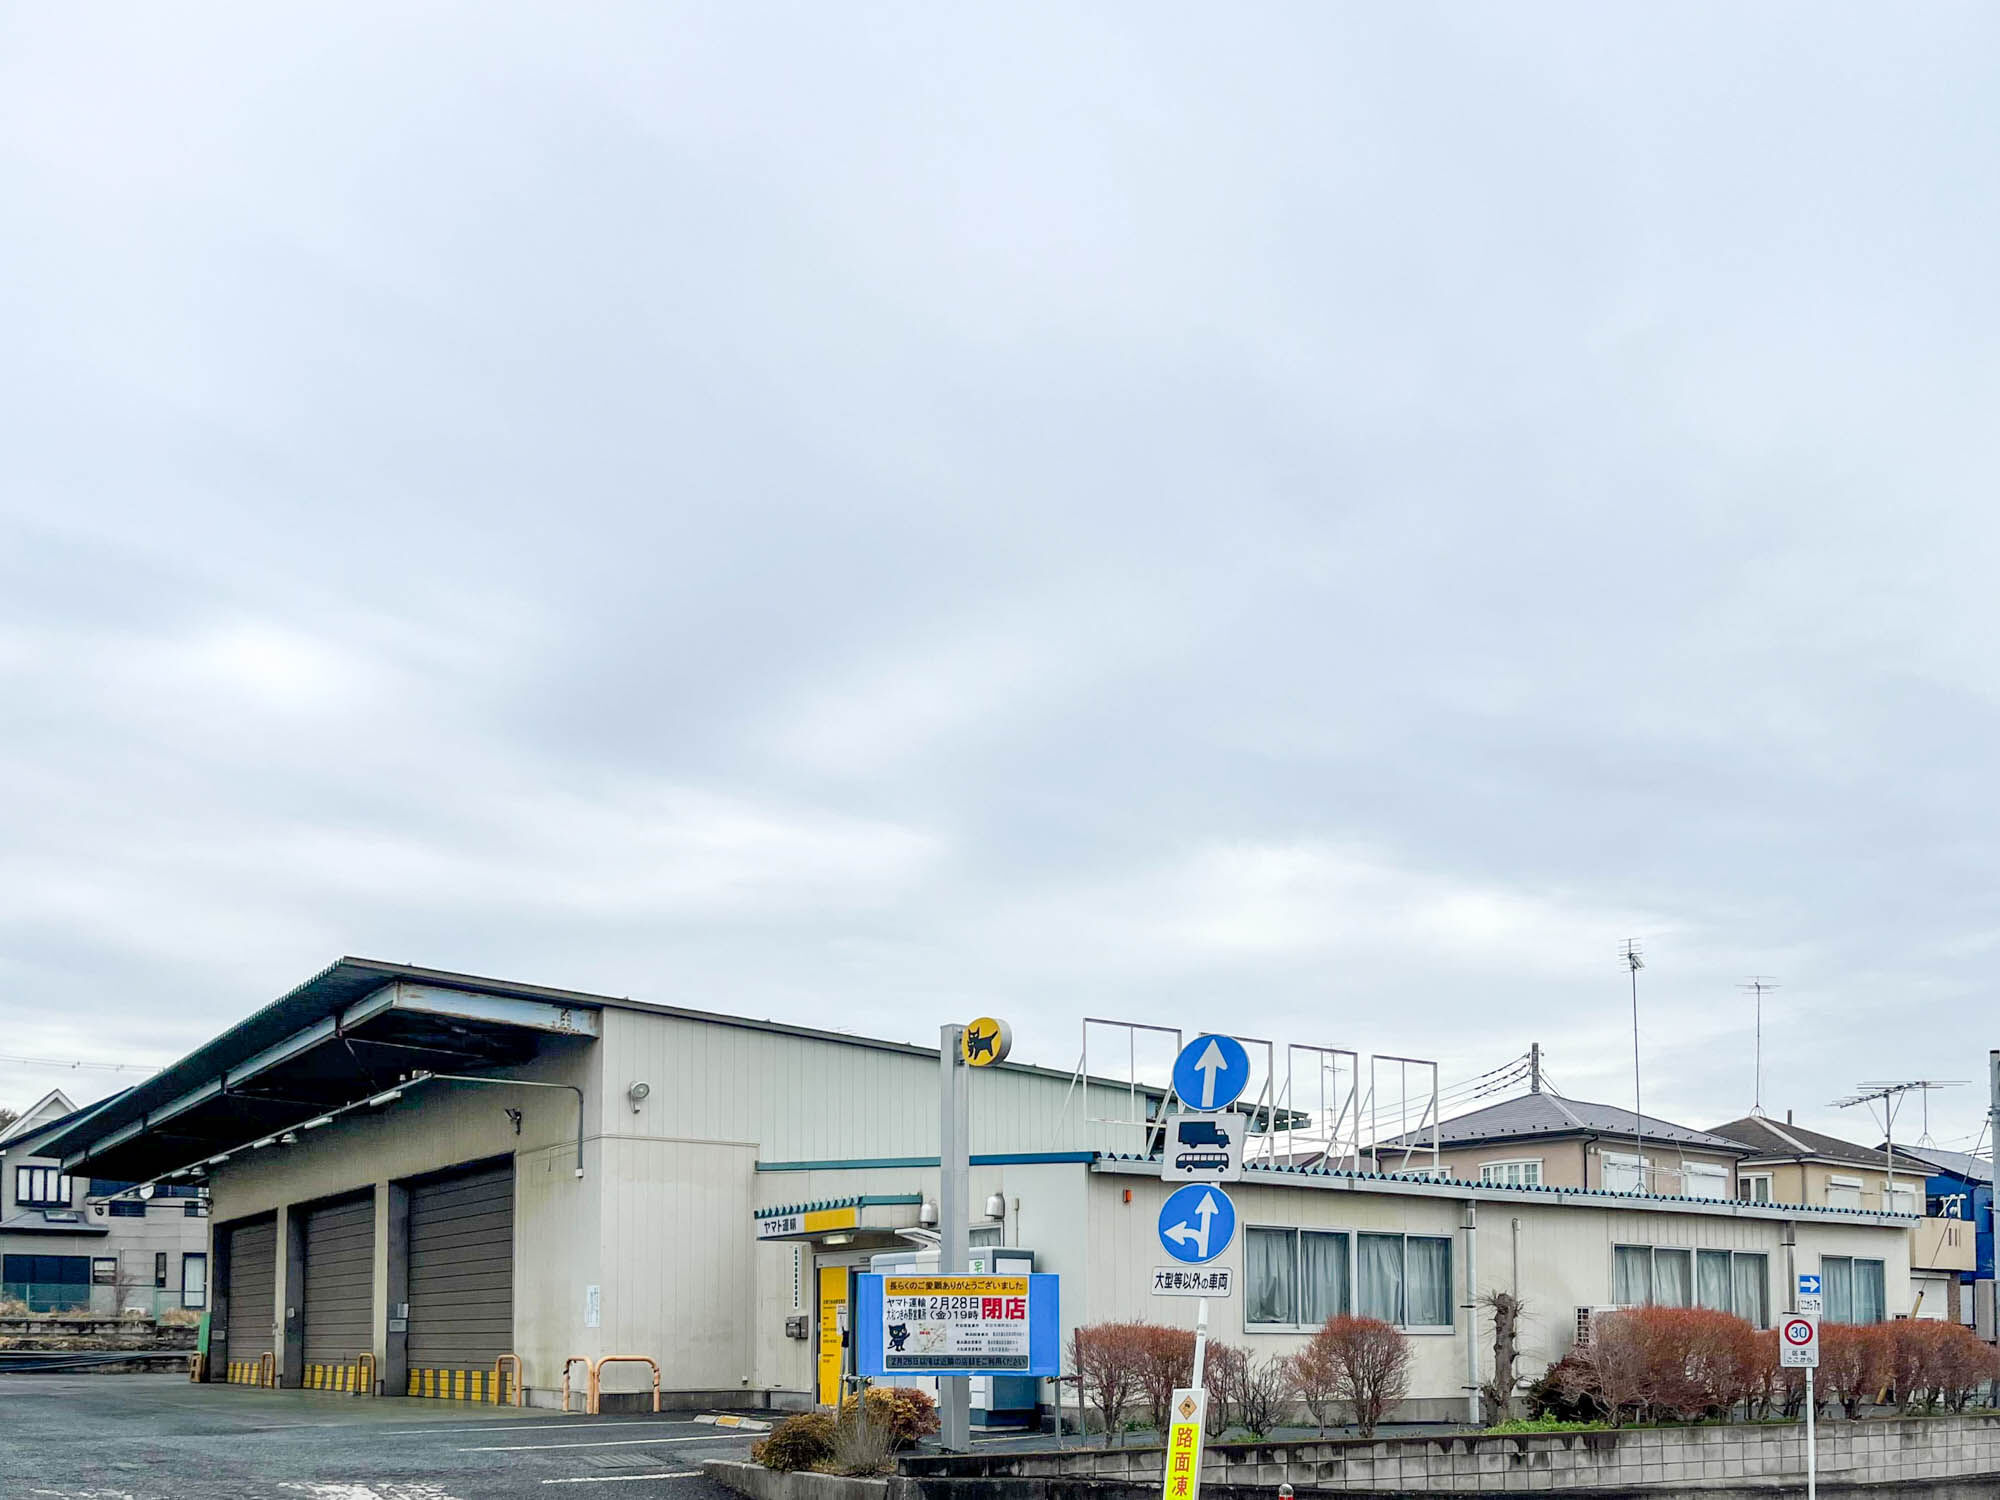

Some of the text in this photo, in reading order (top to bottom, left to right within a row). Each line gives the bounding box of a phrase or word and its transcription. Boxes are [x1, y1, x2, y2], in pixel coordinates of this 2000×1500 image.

[1154, 1272, 1228, 1290] 大型等以外の車両
[886, 1297, 926, 1308] ヤマト運輸
[929, 1297, 979, 1310] 2月28日
[981, 1297, 1026, 1320] 閉店
[1791, 1327, 1807, 1338] 30
